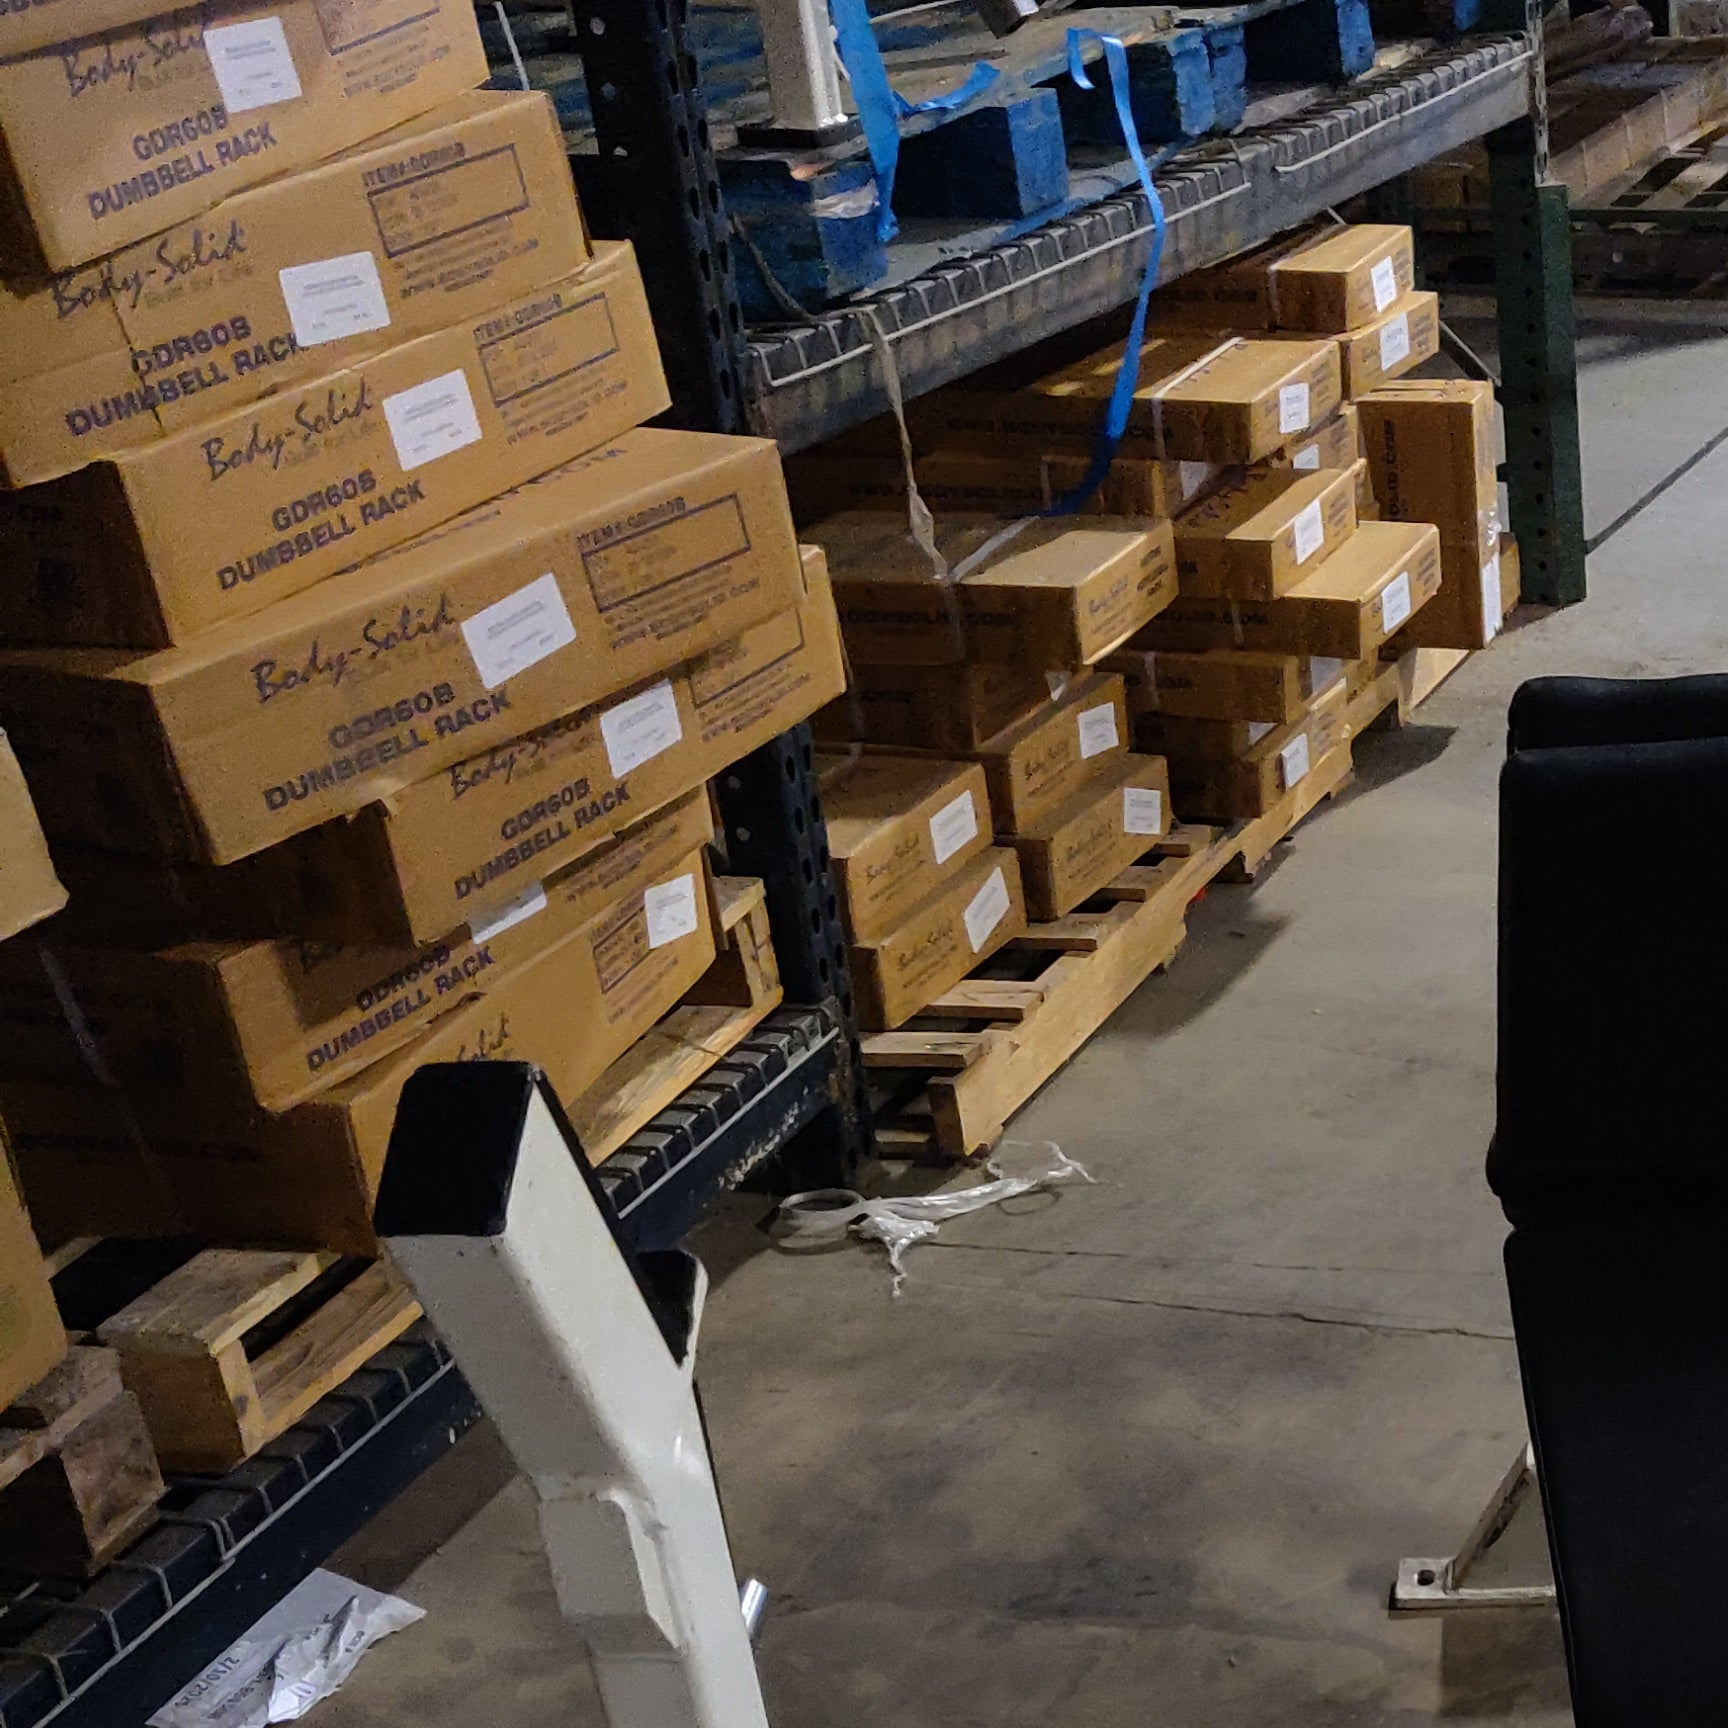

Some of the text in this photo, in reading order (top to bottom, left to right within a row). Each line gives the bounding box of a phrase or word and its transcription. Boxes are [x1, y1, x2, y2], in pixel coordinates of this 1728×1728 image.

[88, 121, 277, 219] DUMBBELL RACK
[65, 362, 229, 436] DUMBBELL
[200, 373, 372, 481] Body-Solid
[216, 479, 426, 590] DUMBBELL RACK
[250, 592, 453, 703] Body-Solid
[263, 688, 512, 812] DUMBBELL RACK
[454, 820, 571, 899] DUMBBELL
[574, 780, 631, 829] RACK
[306, 945, 496, 1073] DUMBBELL RACK
